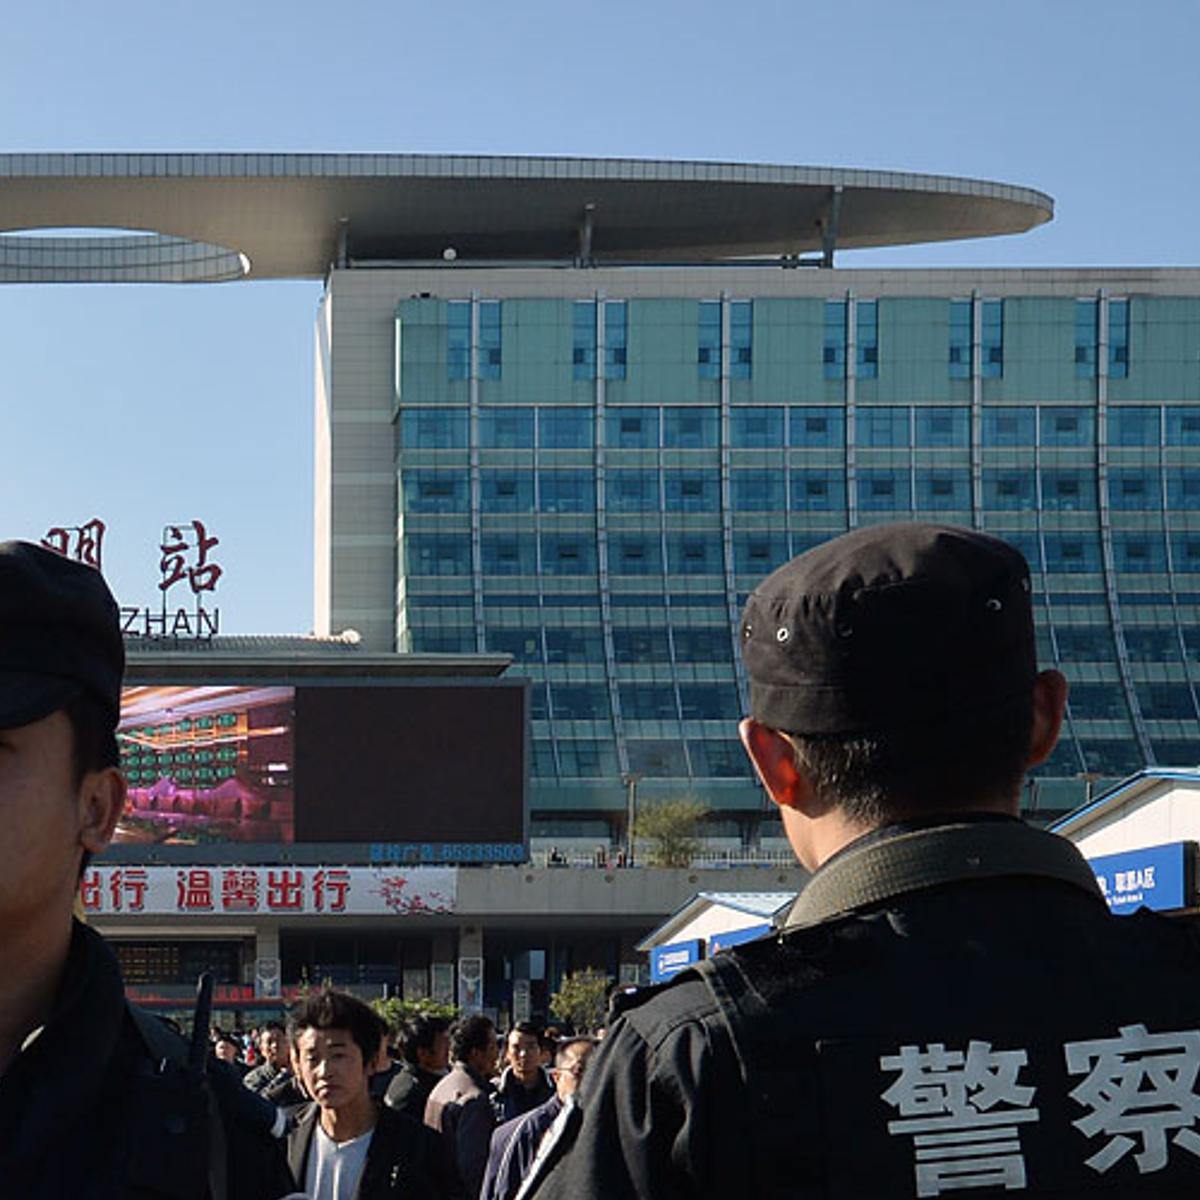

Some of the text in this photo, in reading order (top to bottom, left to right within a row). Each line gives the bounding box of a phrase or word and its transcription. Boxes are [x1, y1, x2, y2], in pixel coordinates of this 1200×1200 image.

[120, 607, 220, 635] ZHAN
[176, 870, 351, 911] 温馨出行
[878, 1023, 1200, 1199] 警察
